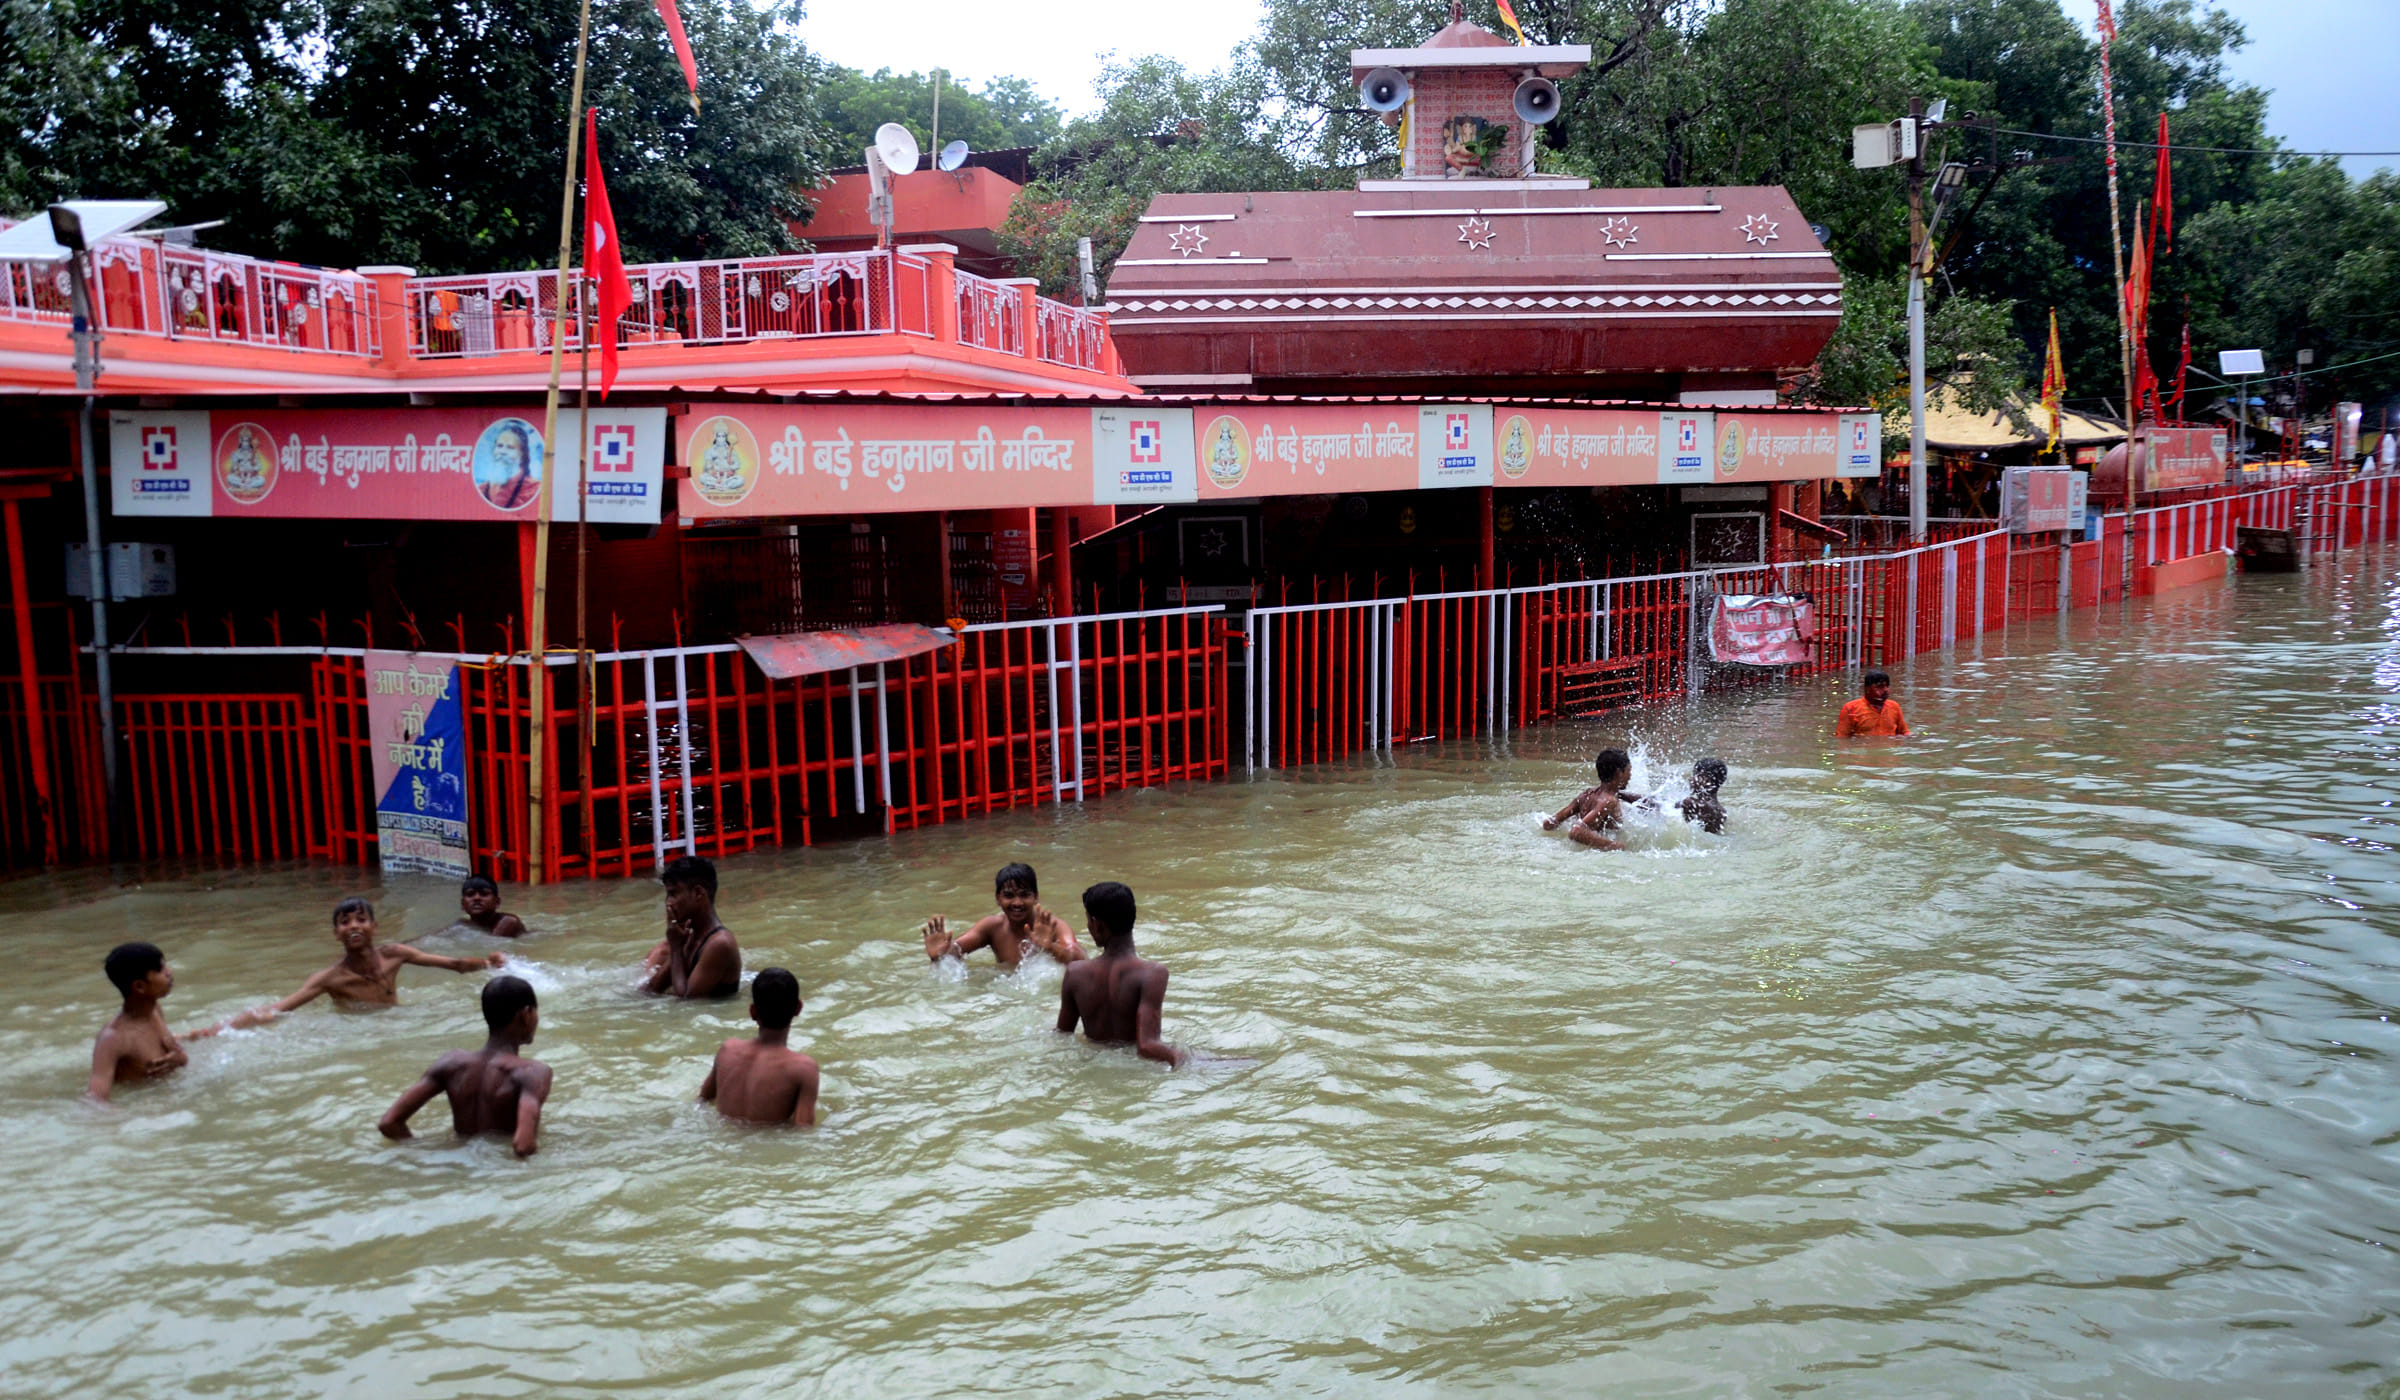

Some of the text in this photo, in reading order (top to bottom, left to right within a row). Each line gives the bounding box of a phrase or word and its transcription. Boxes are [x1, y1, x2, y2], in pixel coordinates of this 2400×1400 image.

[281, 433, 473, 488] श्री बड़े हनुमान जी मन्दिर
[769, 425, 1075, 493] श्री बड़े हनुमान जी मन्दिर
[1255, 422, 1415, 475] श्री बड़े हनुमान जी मन्दिर
[1537, 423, 1656, 470] श्री बड़े हनुमान जी मन्दिर
[374, 664, 450, 700] आप कैमरे
[401, 703, 425, 736] की
[427, 738, 444, 772] में
[411, 776, 426, 811] है
